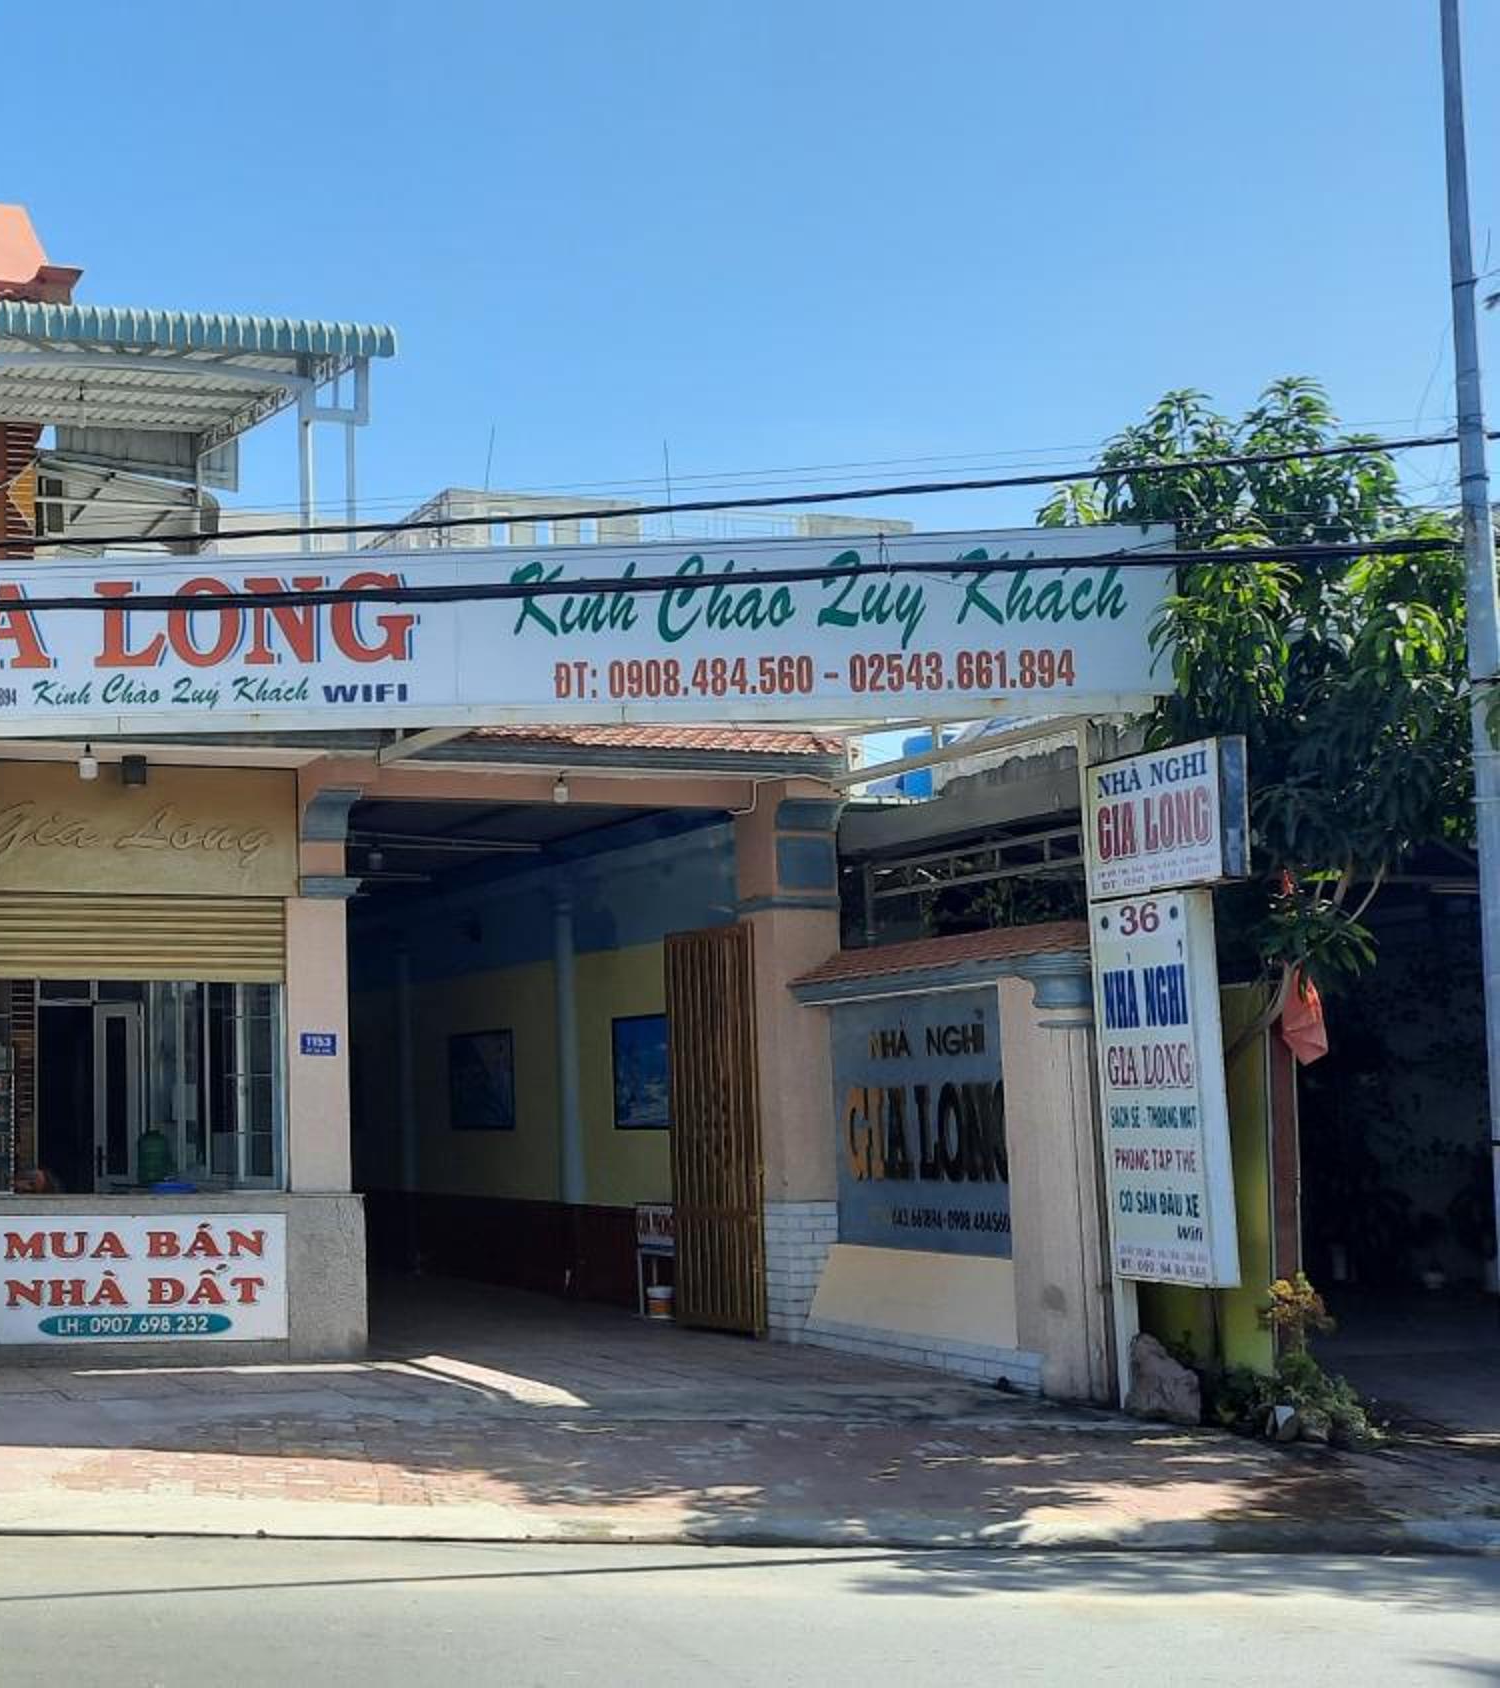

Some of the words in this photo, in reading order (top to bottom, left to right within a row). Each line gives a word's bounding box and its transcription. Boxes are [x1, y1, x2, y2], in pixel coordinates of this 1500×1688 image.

[93, 572, 419, 666] LONG
[101, 673, 160, 705] Chào
[323, 684, 408, 703] WIFI
[554, 662, 597, 699] ĐT:
[608, 655, 814, 699] 0908.484.560
[850, 649, 1075, 693] 02543.661.894
[1097, 762, 1143, 799] NHÀ
[1098, 799, 1137, 863] GIA
[1143, 785, 1212, 856] LONG
[1119, 902, 1160, 936] 36
[1107, 1045, 1141, 1089] GIA
[1142, 1043, 1193, 1089] LONG
[843, 1087, 915, 1182] GIA
[1185, 1193, 1200, 1218] XE
[4, 1231, 131, 1260] MUA
[146, 1222, 266, 1259] BÁN
[4, 1269, 131, 1307] NHÀ
[147, 1263, 266, 1306] ĐẤT
[57, 1319, 84, 1334] LH:
[90, 1316, 209, 1333] 0907.698.232
